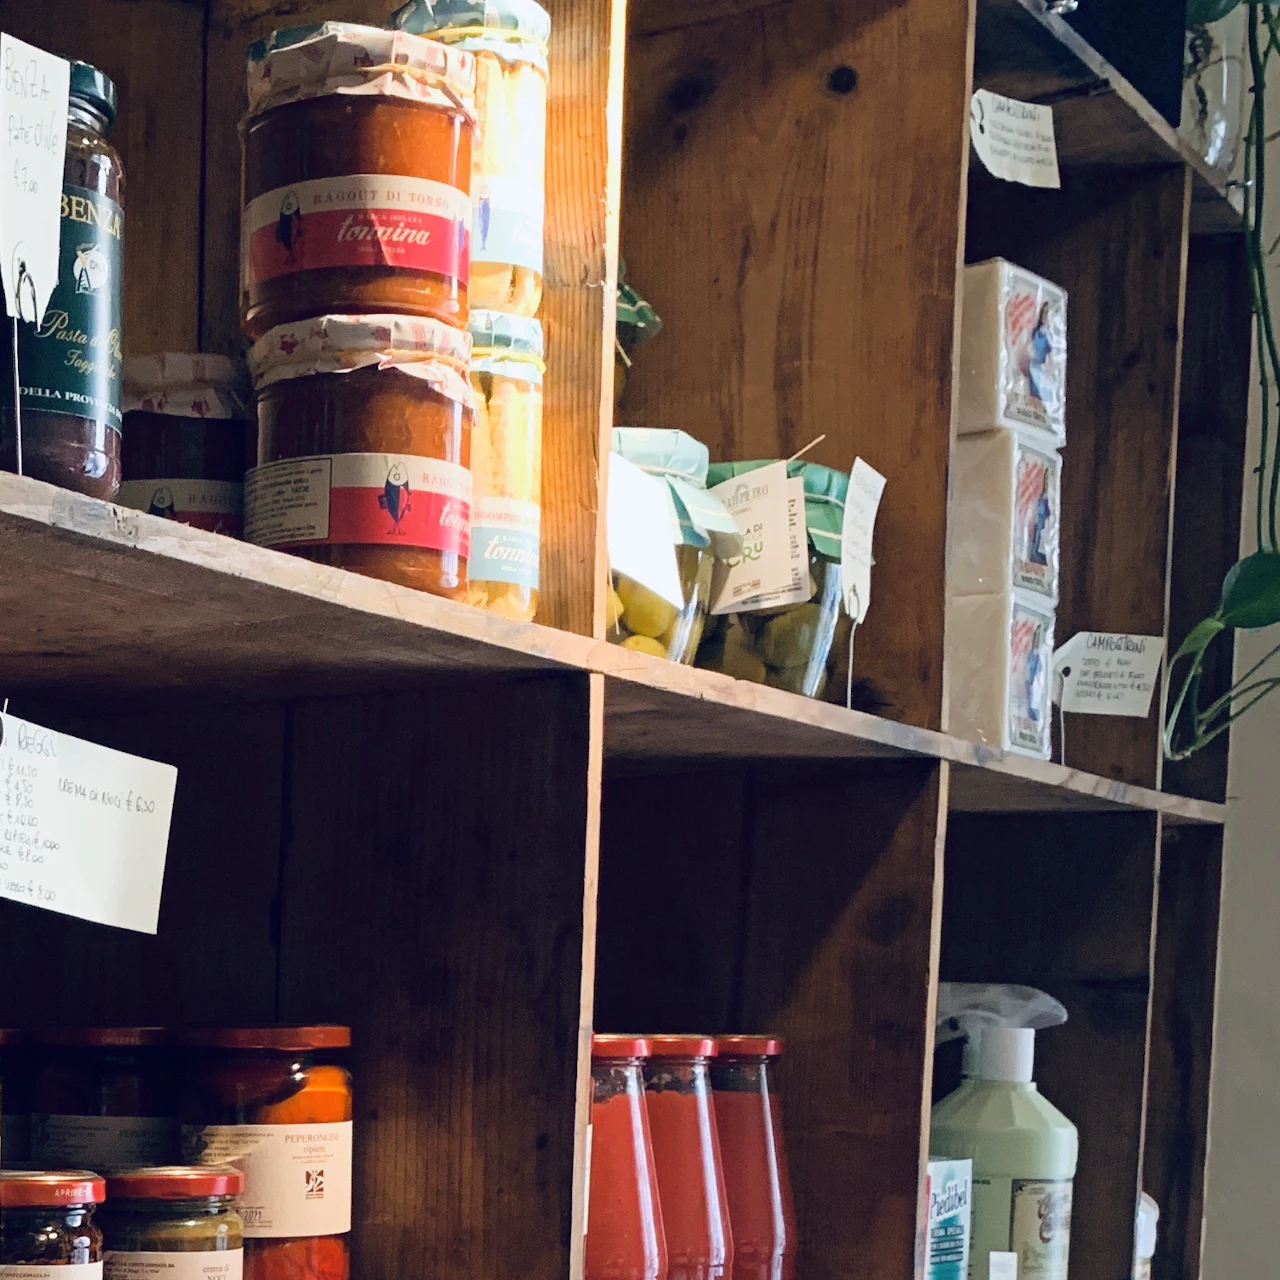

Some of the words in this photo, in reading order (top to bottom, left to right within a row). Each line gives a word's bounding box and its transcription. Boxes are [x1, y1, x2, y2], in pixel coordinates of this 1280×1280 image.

[312, 190, 378, 206] RAGOUT
[386, 190, 401, 202] DI
[408, 192, 449, 209] TONNO
[34, 309, 88, 346] Pasta
[19, 385, 62, 400] DELLA
[58, 777, 87, 801] CREMA
[284, 1131, 339, 1144] PEPERONCINI
[244, 1210, 262, 1221] 2021
